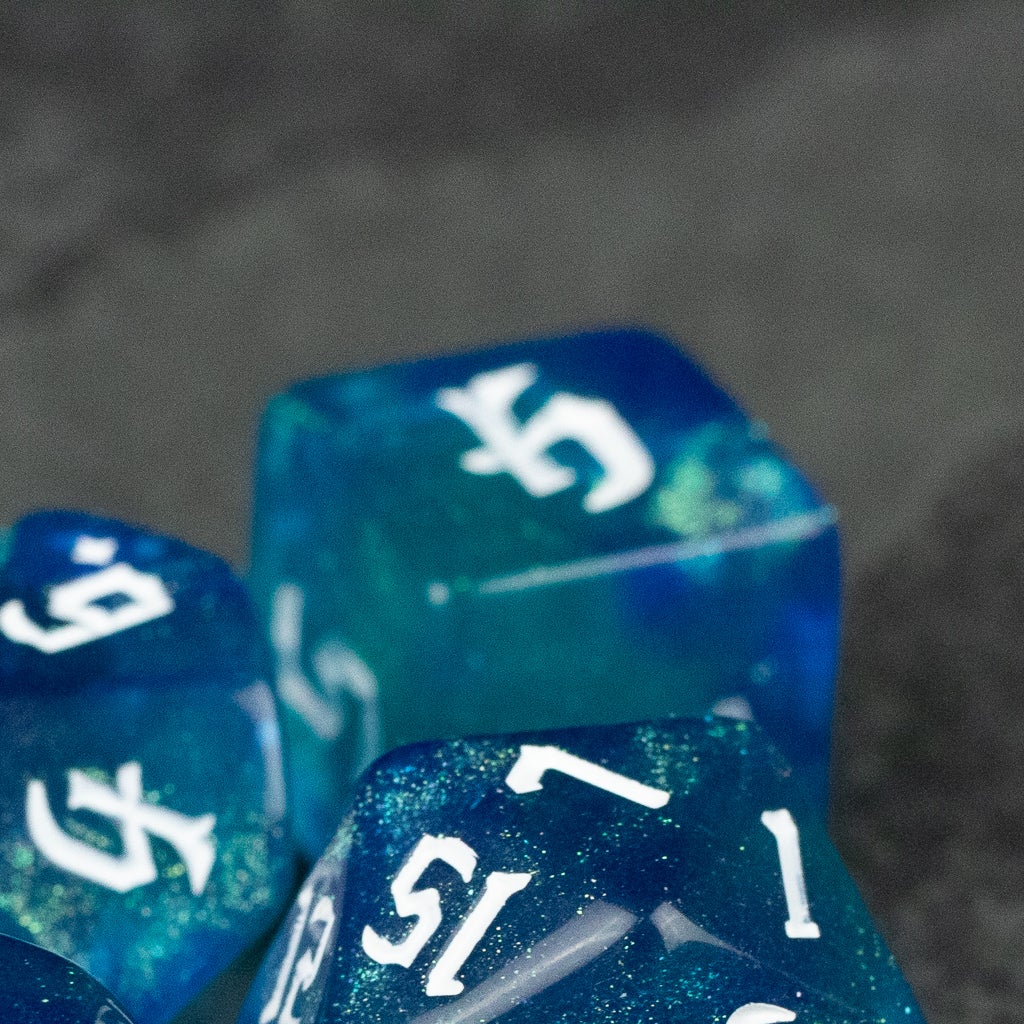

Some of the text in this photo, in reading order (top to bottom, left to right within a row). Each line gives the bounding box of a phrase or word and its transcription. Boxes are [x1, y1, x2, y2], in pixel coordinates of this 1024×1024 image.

[28, 764, 214, 892] 4
[762, 809, 820, 938] 1
[361, 834, 532, 997] 15
